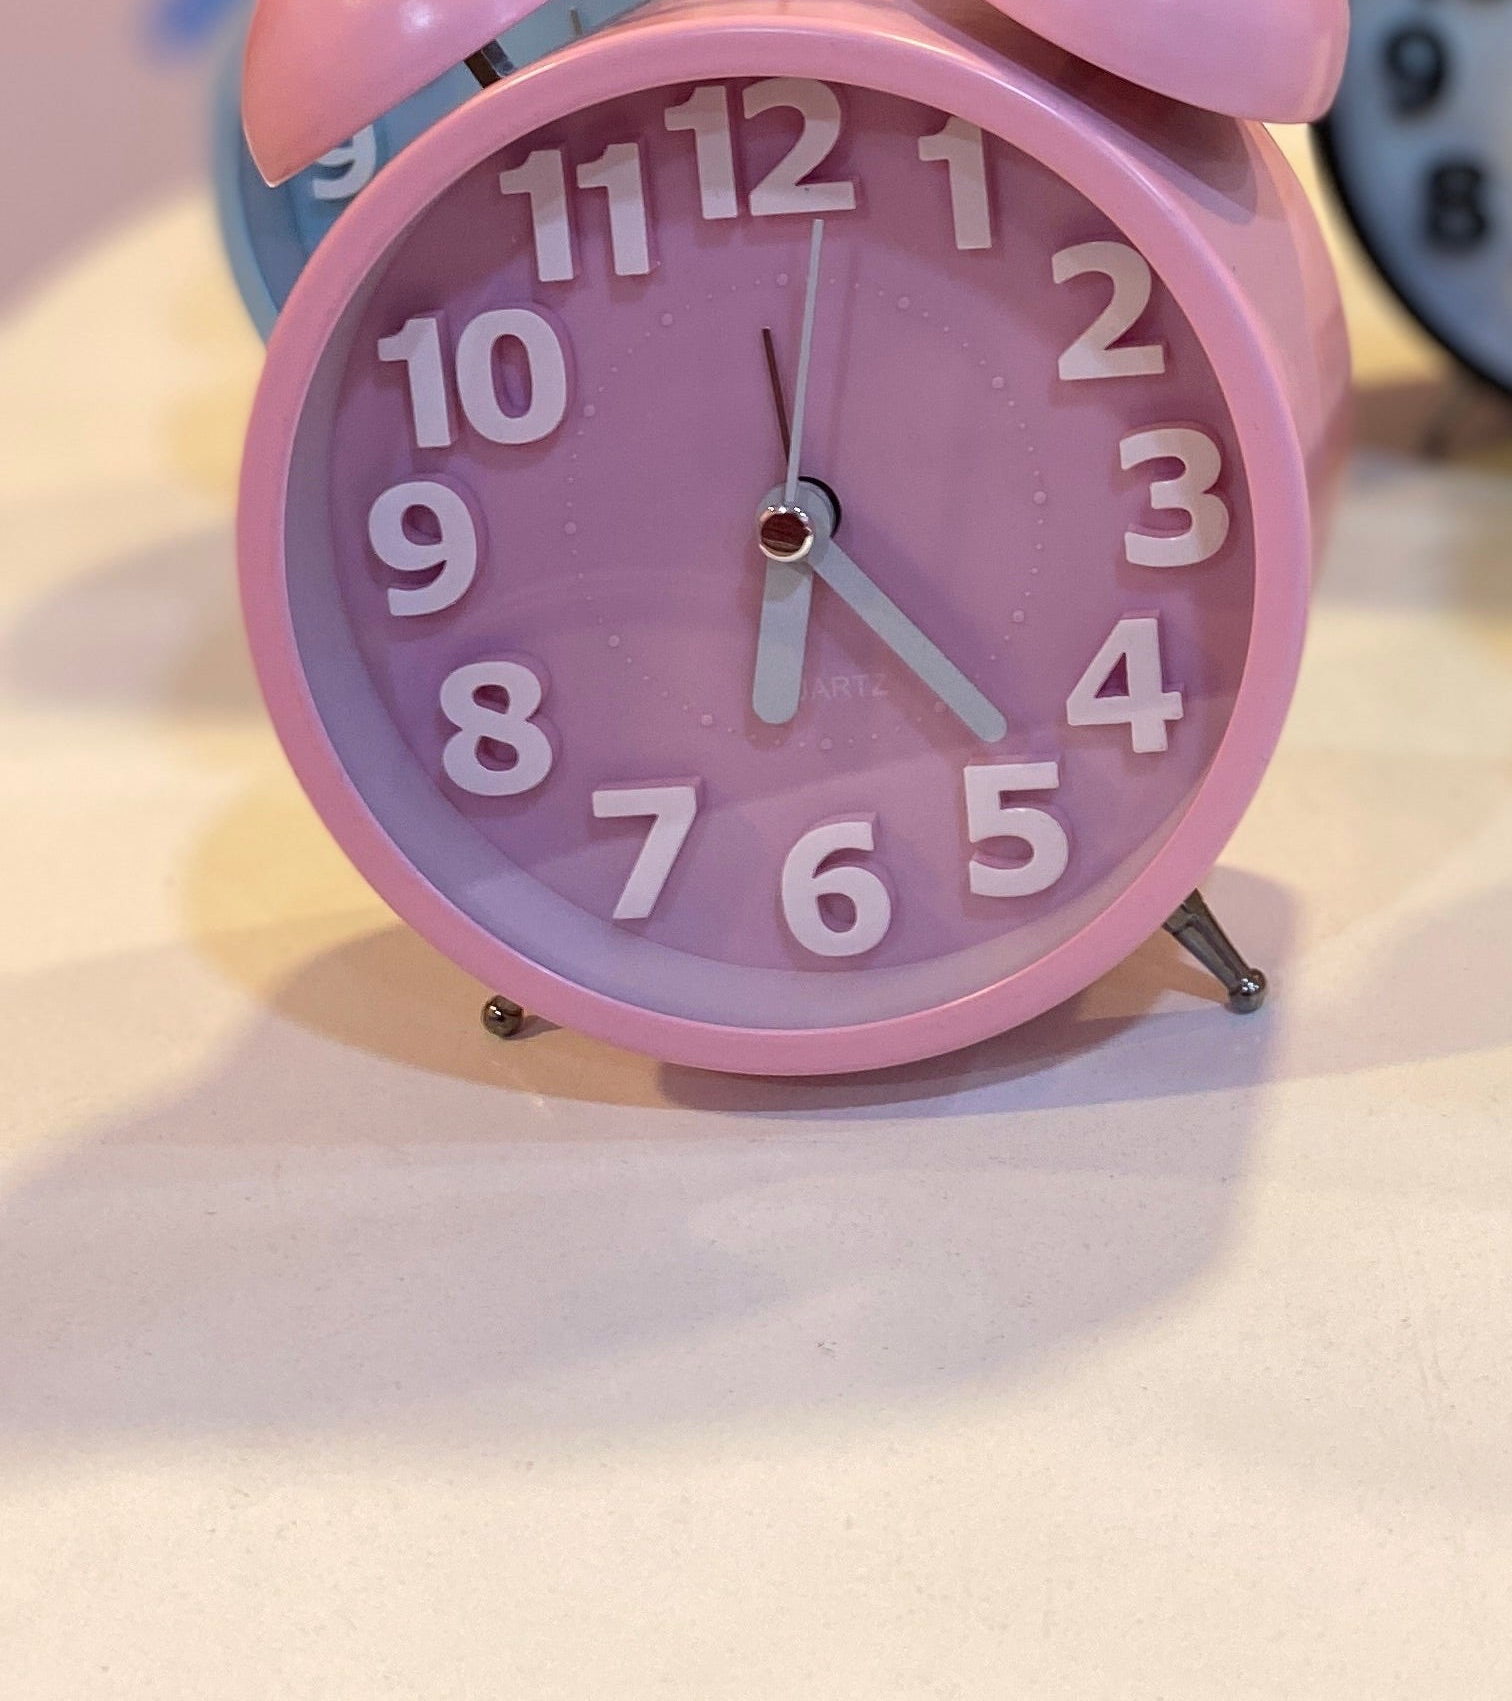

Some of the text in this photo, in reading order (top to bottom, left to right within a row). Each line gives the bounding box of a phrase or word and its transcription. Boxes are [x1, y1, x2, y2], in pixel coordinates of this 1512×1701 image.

[1380, 20, 1452, 117] 9
[500, 142, 651, 283] 11
[666, 78, 856, 219] 12
[918, 117, 993, 250] 1
[1422, 161, 1491, 254] 8
[1051, 240, 1164, 381] 2
[378, 309, 568, 447] 10
[368, 481, 478, 616] 9
[1119, 429, 1230, 568] 3
[441, 662, 550, 795] 8
[1066, 615, 1183, 754] 4
[593, 787, 695, 918] 7
[782, 822, 890, 956] 6
[964, 762, 1067, 896] 5
